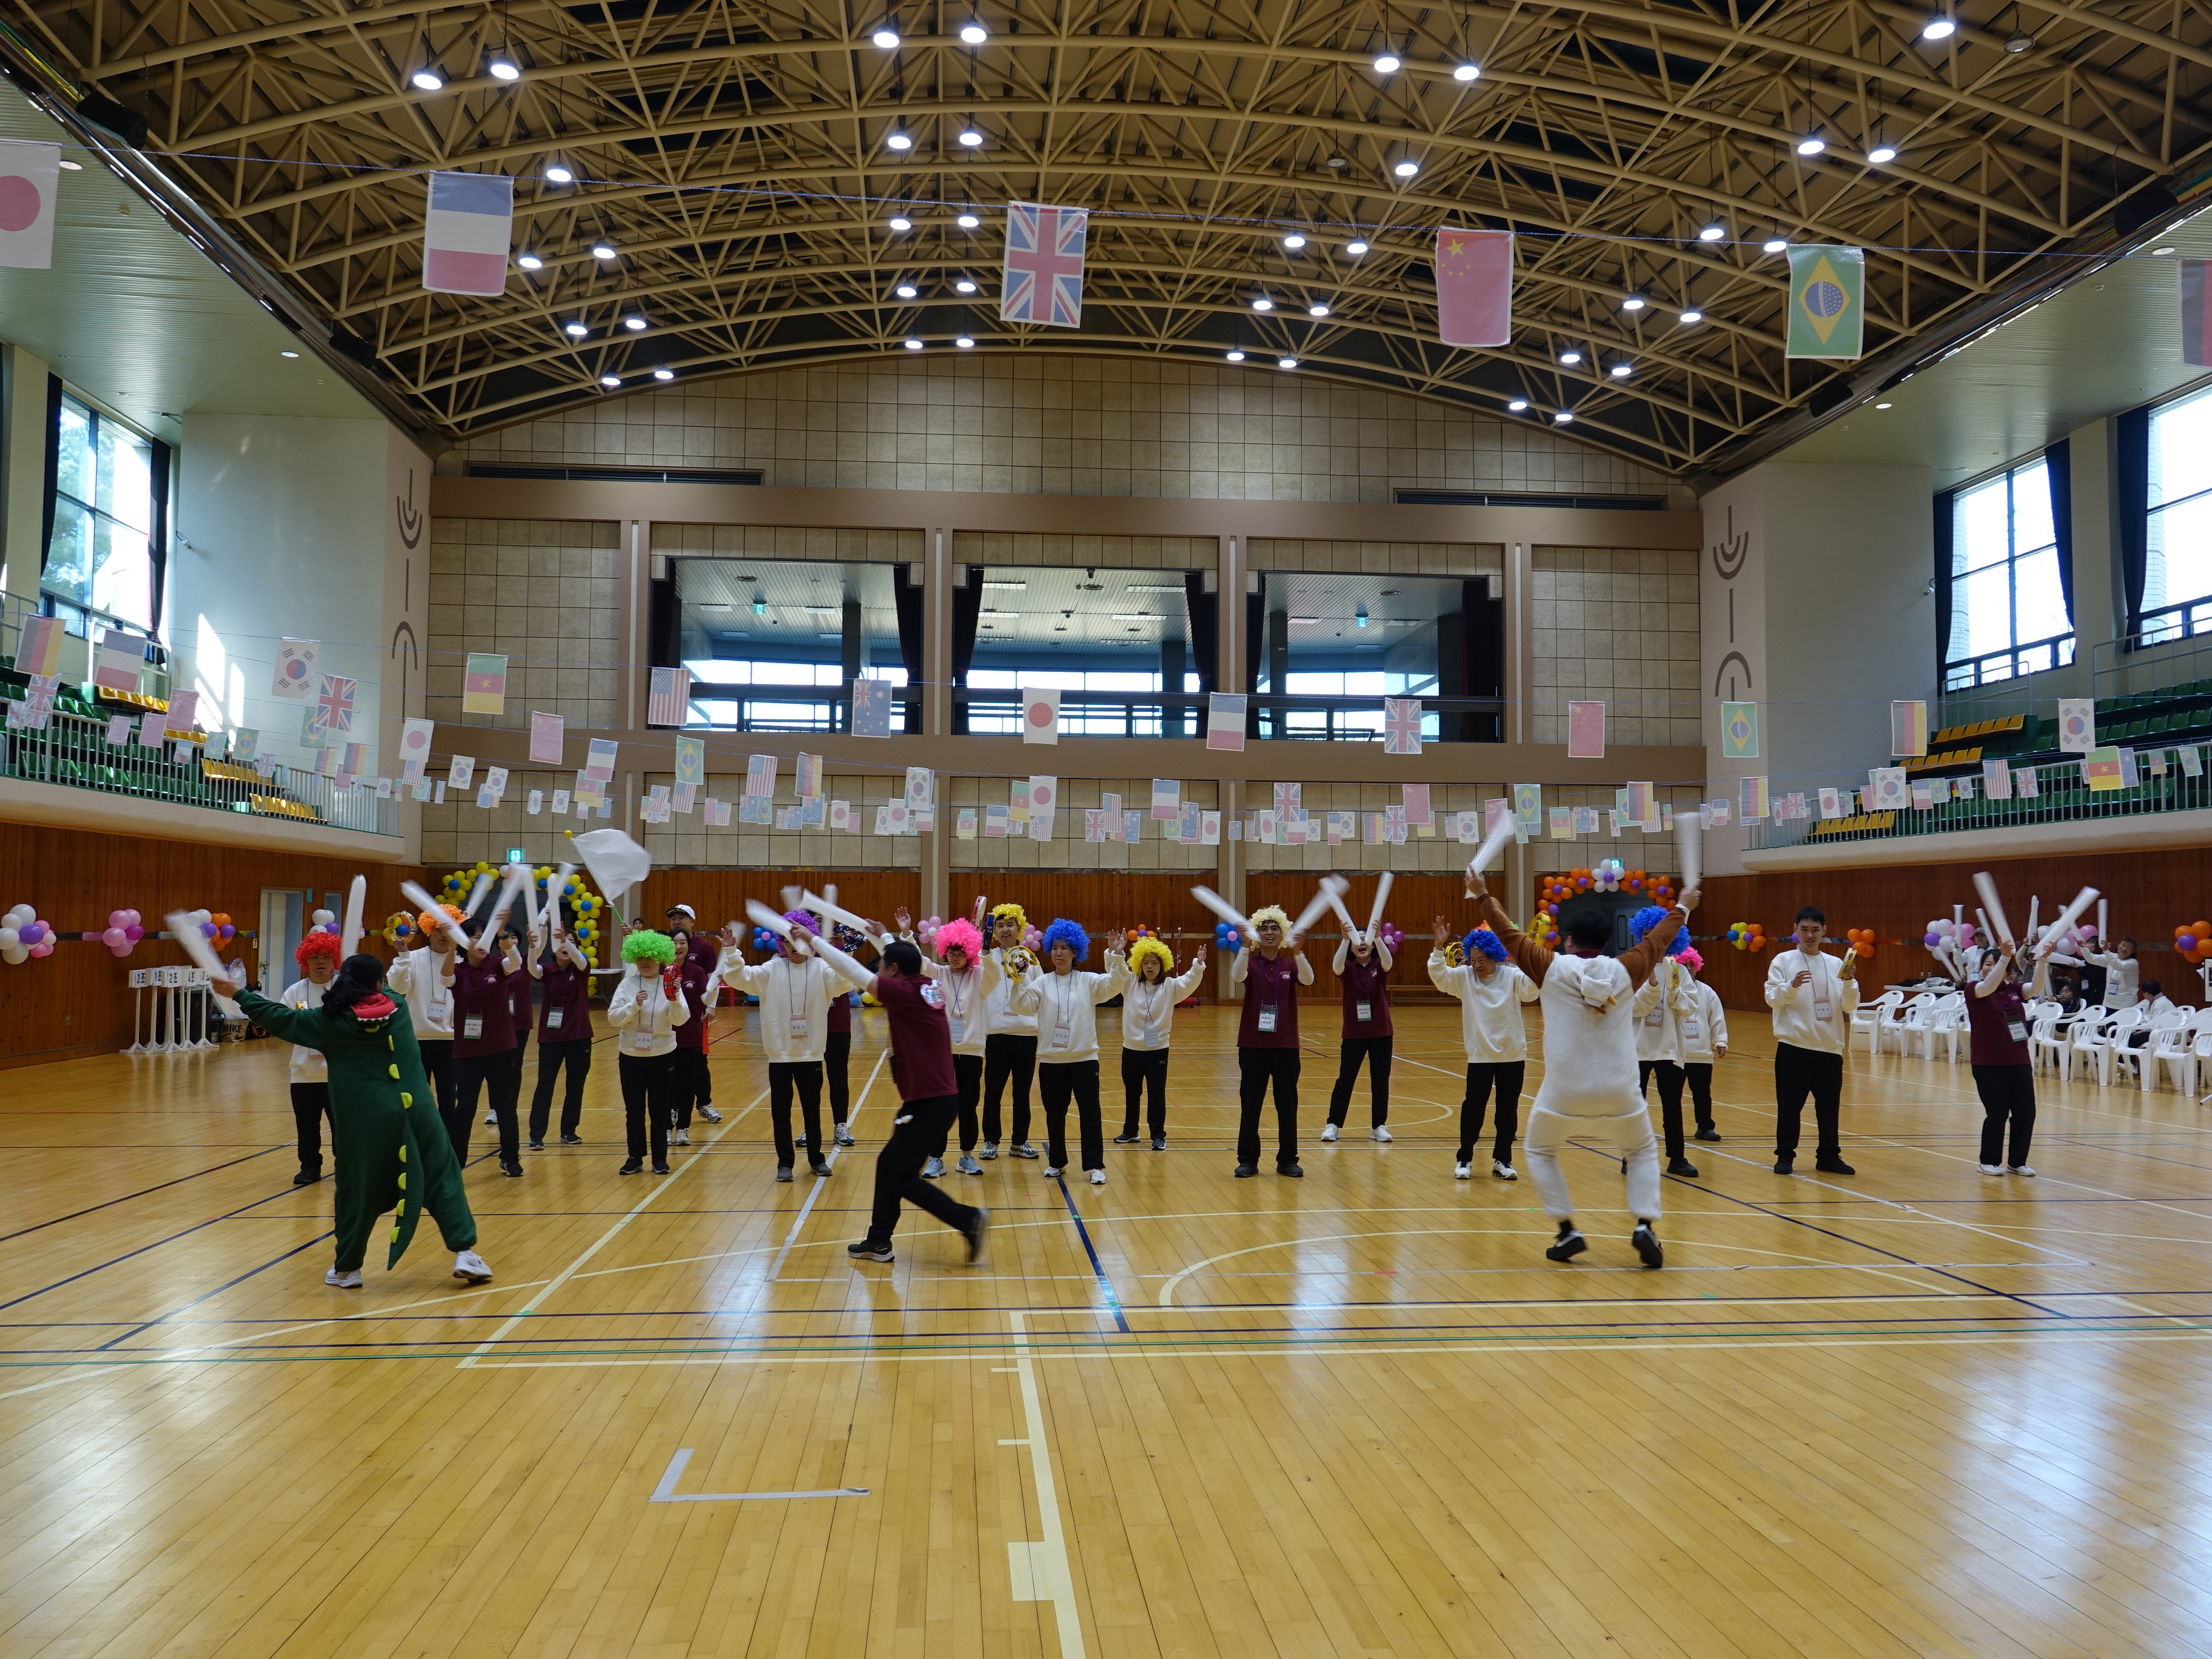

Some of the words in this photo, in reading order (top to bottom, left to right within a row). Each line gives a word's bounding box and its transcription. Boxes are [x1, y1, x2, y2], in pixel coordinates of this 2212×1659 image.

[137, 973, 146, 984] 3조
[155, 971, 162, 982] 1조
[169, 973, 178, 984] 2조
[188, 972, 195, 982] 4조
[224, 1024, 243, 1033] NIKE
